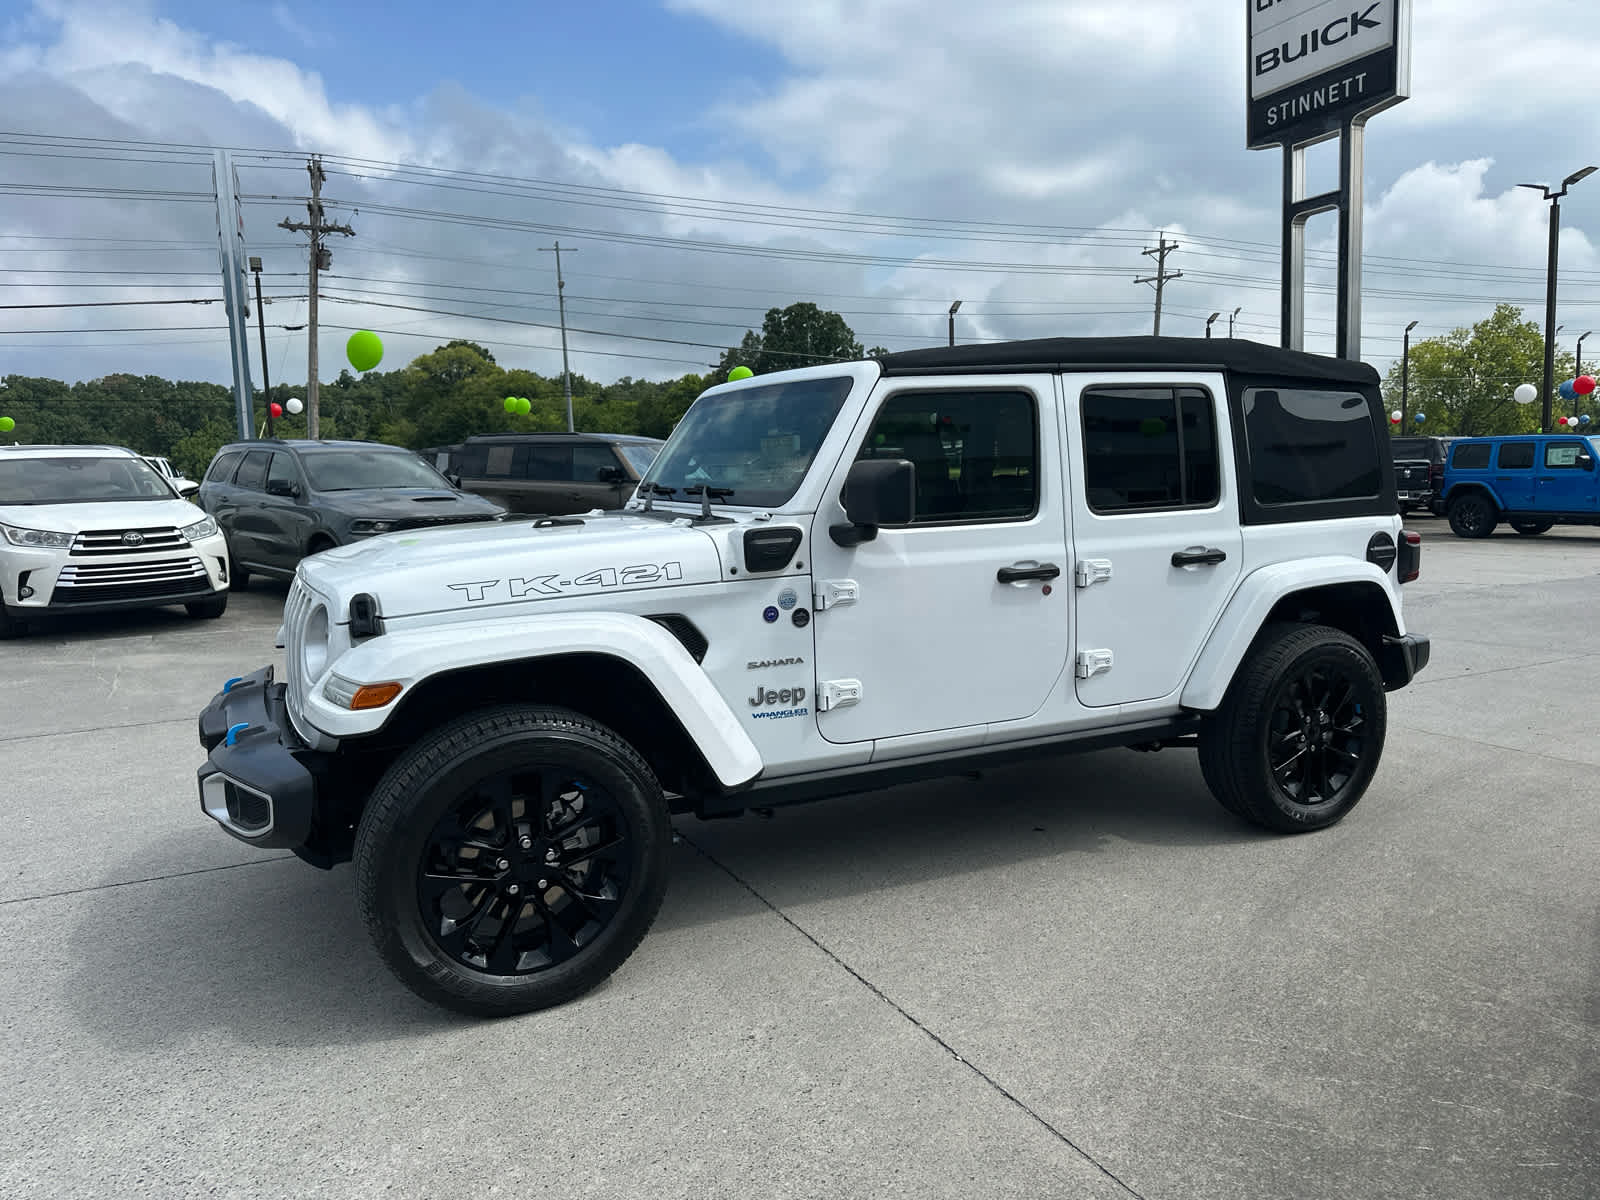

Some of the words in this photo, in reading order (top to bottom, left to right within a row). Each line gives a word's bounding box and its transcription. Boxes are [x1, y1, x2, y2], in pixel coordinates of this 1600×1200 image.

[1255, 2, 1381, 76] BUICK
[1267, 72, 1367, 126] STINNETT
[747, 656, 804, 670] SAHARA
[749, 686, 806, 707] Jeep
[752, 707, 808, 719] WRANGLER
